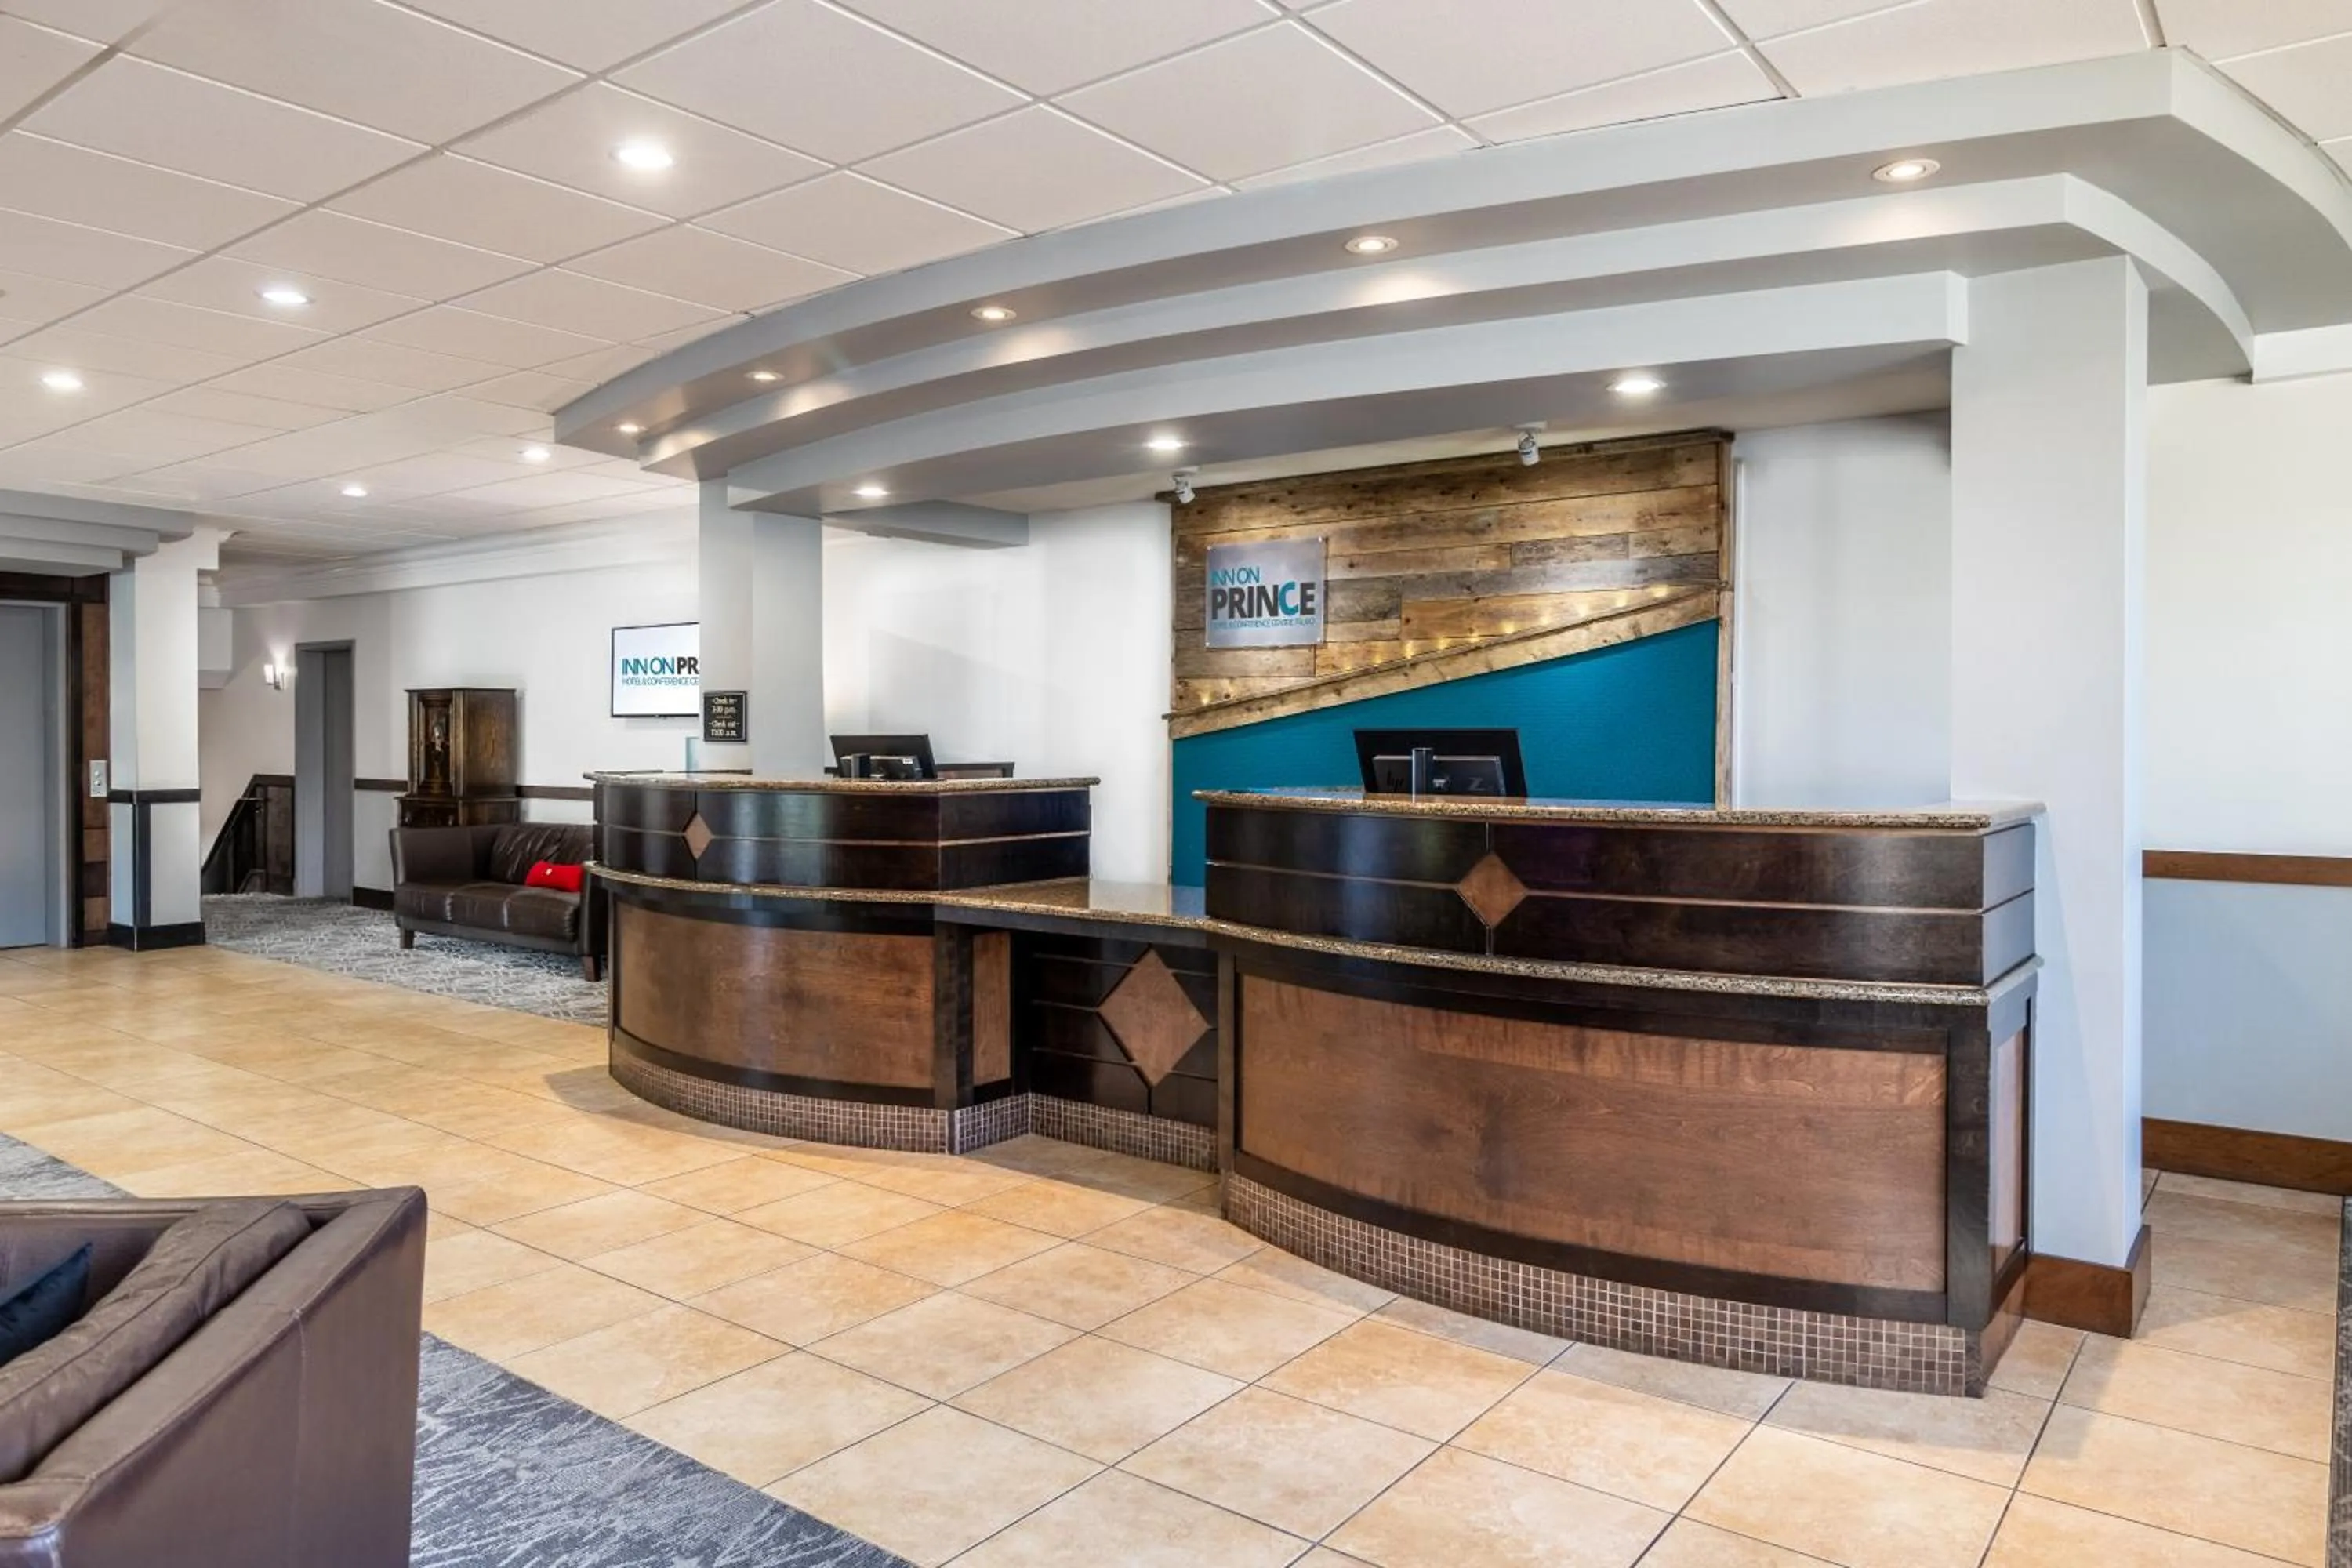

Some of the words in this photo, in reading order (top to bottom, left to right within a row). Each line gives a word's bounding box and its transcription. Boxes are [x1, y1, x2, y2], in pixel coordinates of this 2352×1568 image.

[1236, 567, 1260, 584] ON
[1211, 582, 1316, 619] PRINCE
[622, 658, 648, 675] INN
[650, 657, 675, 675] ON
[647, 677, 688, 685] CONFERENCE
